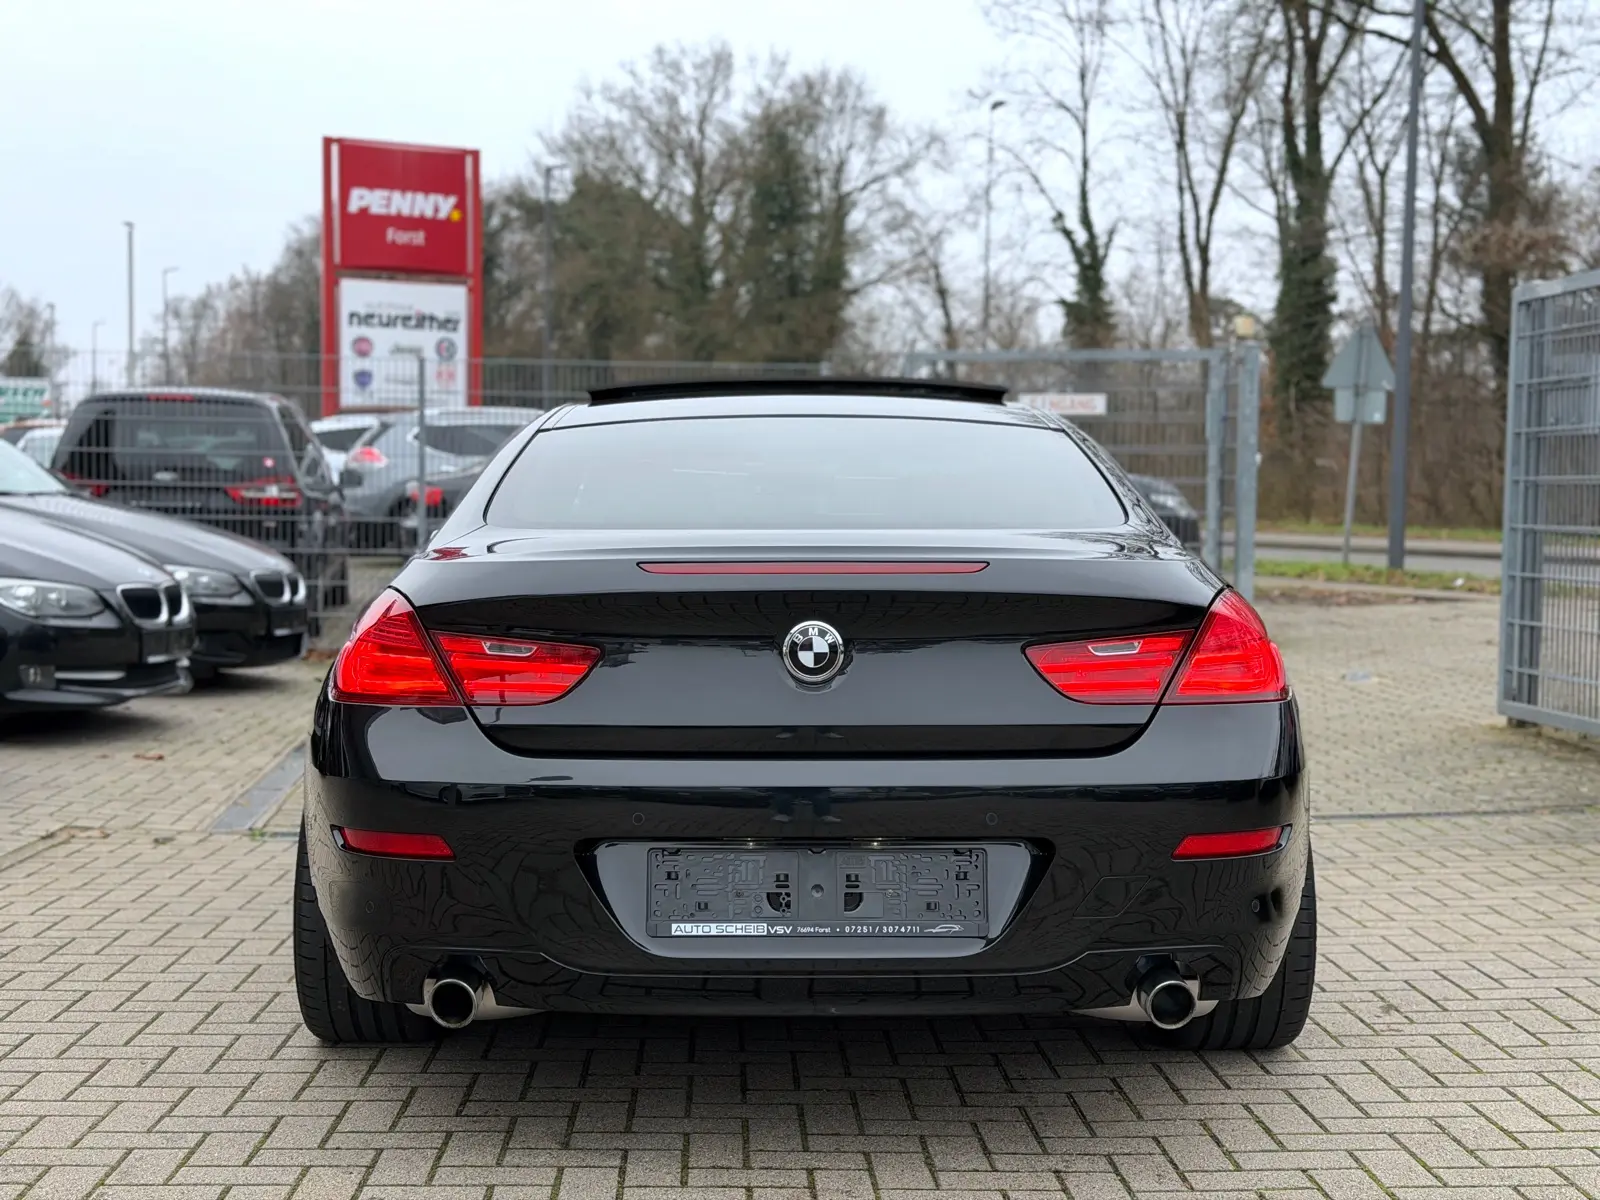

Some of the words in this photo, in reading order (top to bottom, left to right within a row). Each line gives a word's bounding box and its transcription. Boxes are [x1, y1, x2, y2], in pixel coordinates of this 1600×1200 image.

[387, 227, 426, 246] Forst
[793, 627, 835, 643] BMW
[674, 925, 711, 933] AUTO
[716, 925, 765, 933] SCHEIB
[768, 926, 793, 934] VSV
